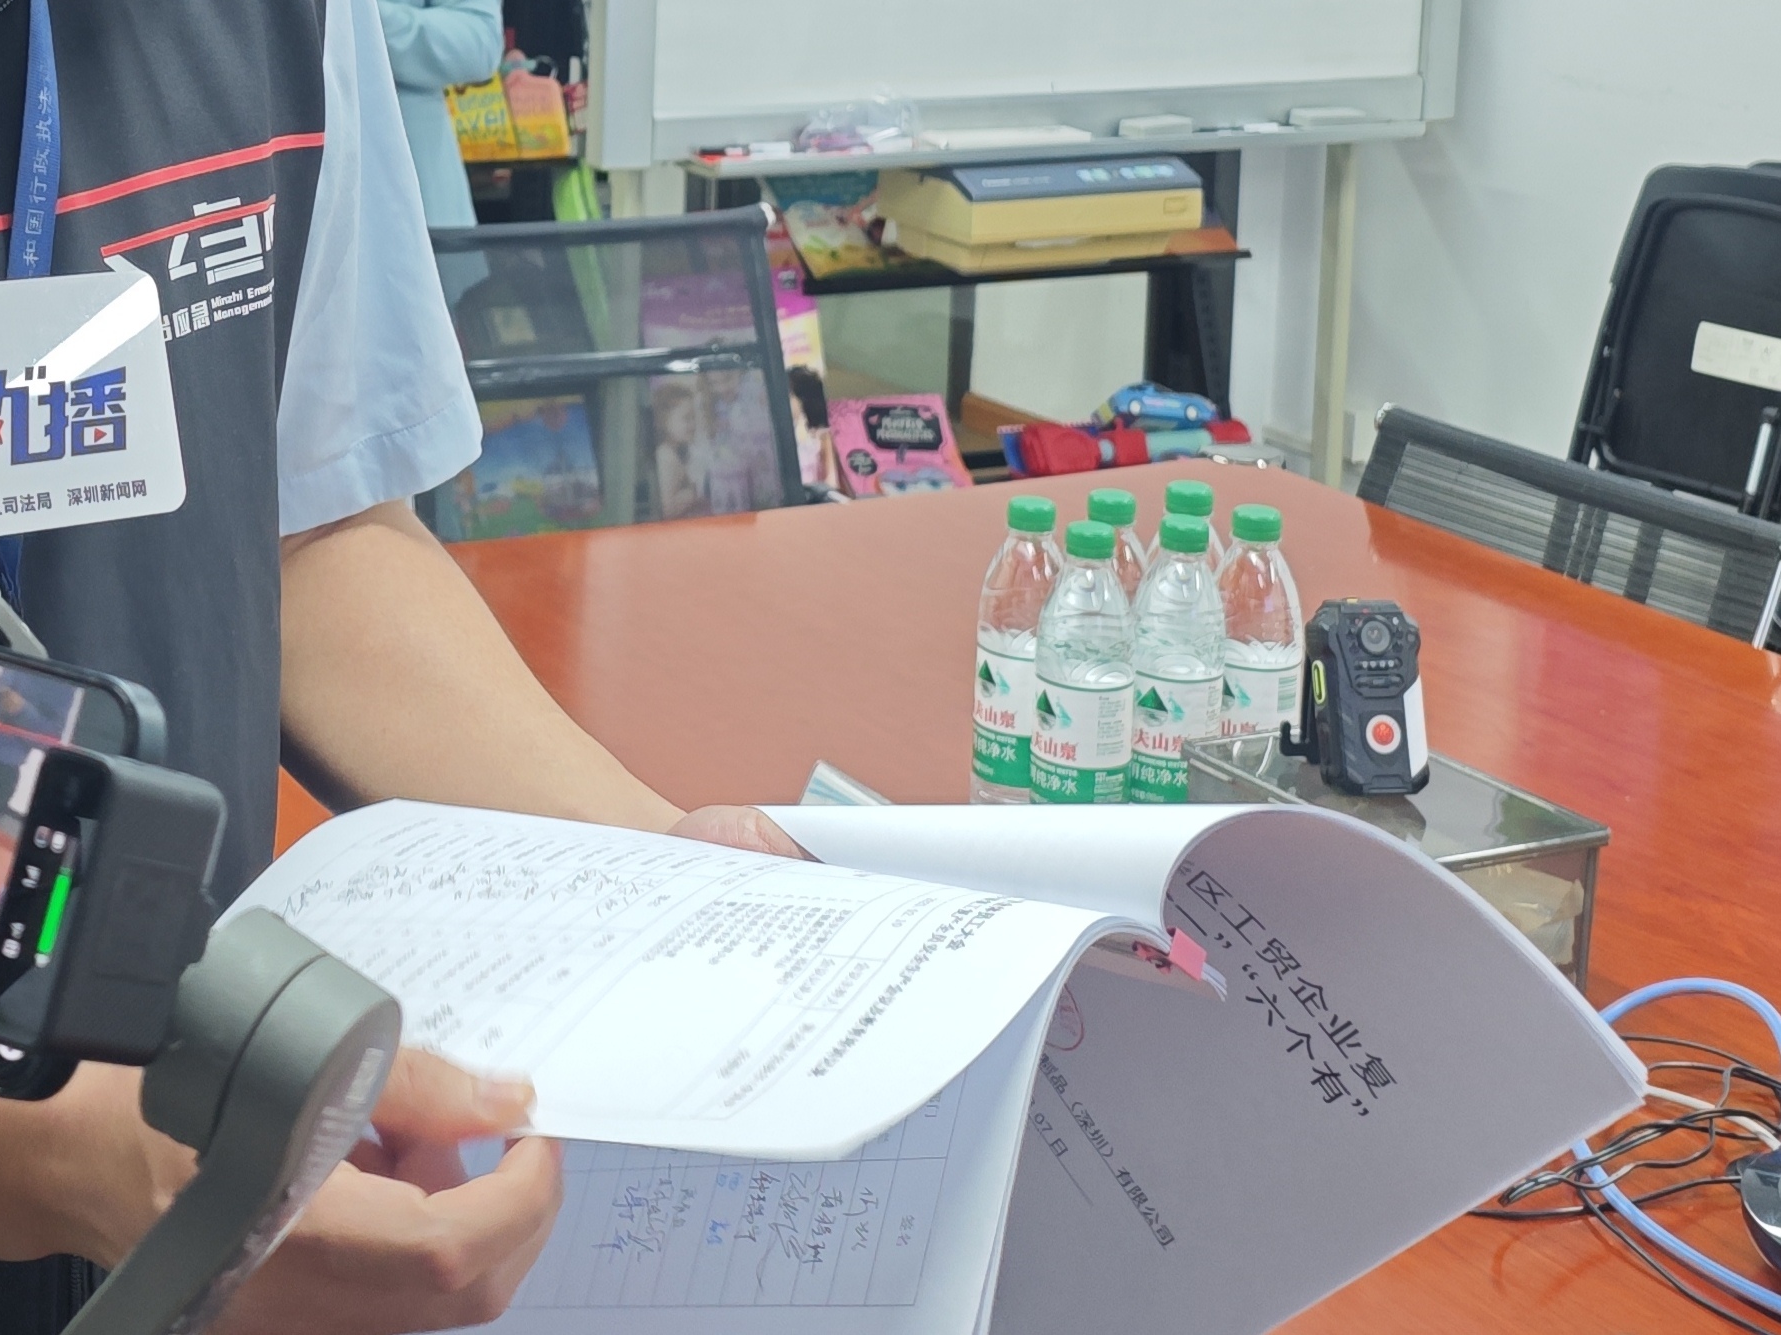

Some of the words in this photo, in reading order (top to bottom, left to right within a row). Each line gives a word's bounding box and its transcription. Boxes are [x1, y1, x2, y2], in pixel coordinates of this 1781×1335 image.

[66, 478, 149, 508] 深圳新闻网
[1177, 858, 1399, 1101] 区工贸企业复
